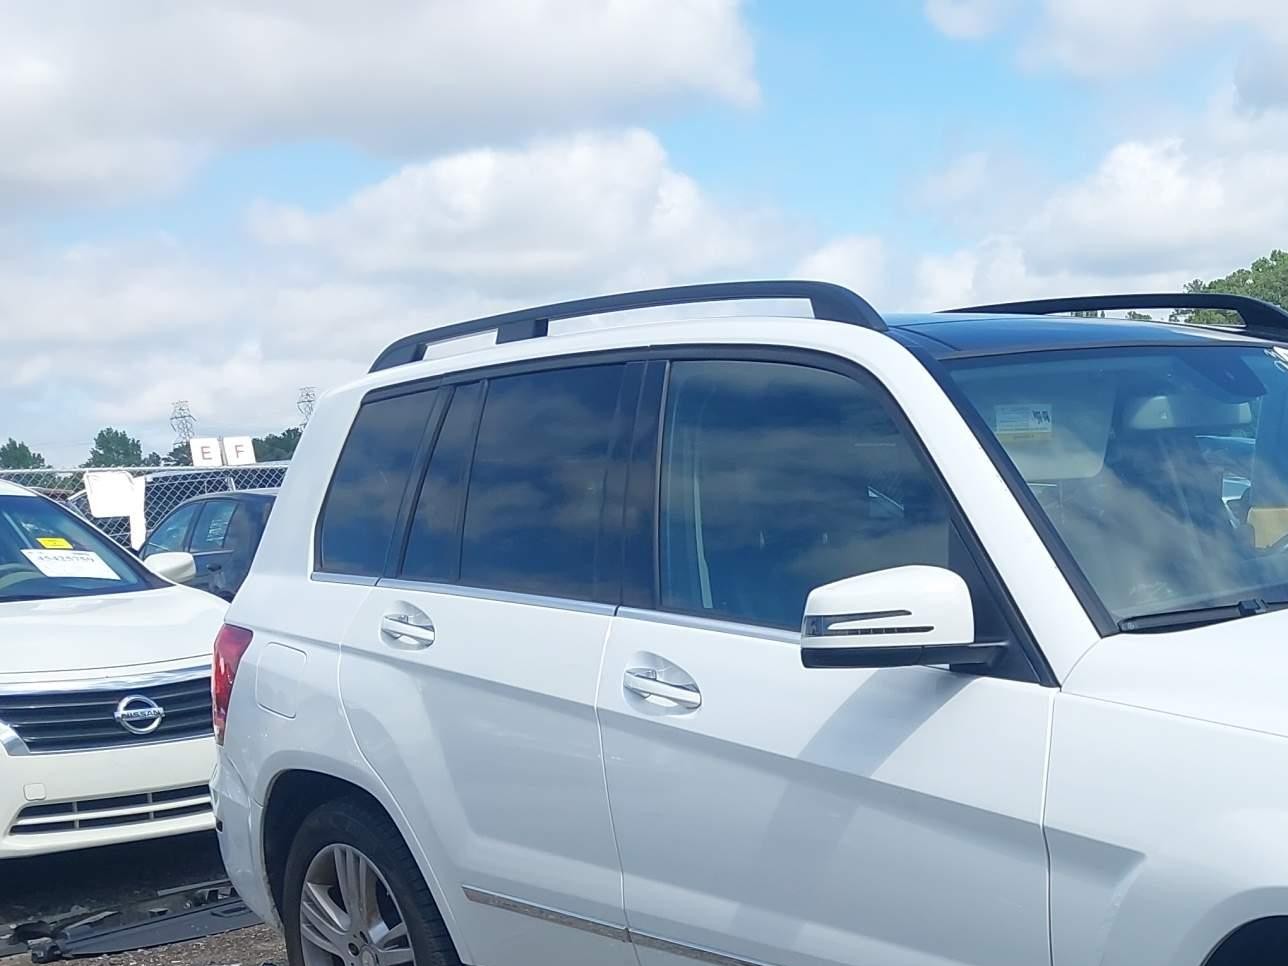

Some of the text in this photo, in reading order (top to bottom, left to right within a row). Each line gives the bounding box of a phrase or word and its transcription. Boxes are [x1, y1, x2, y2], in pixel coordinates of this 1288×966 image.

[201, 446, 214, 461] E
[235, 444, 247, 459] F
[121, 708, 161, 721] NISSAN
